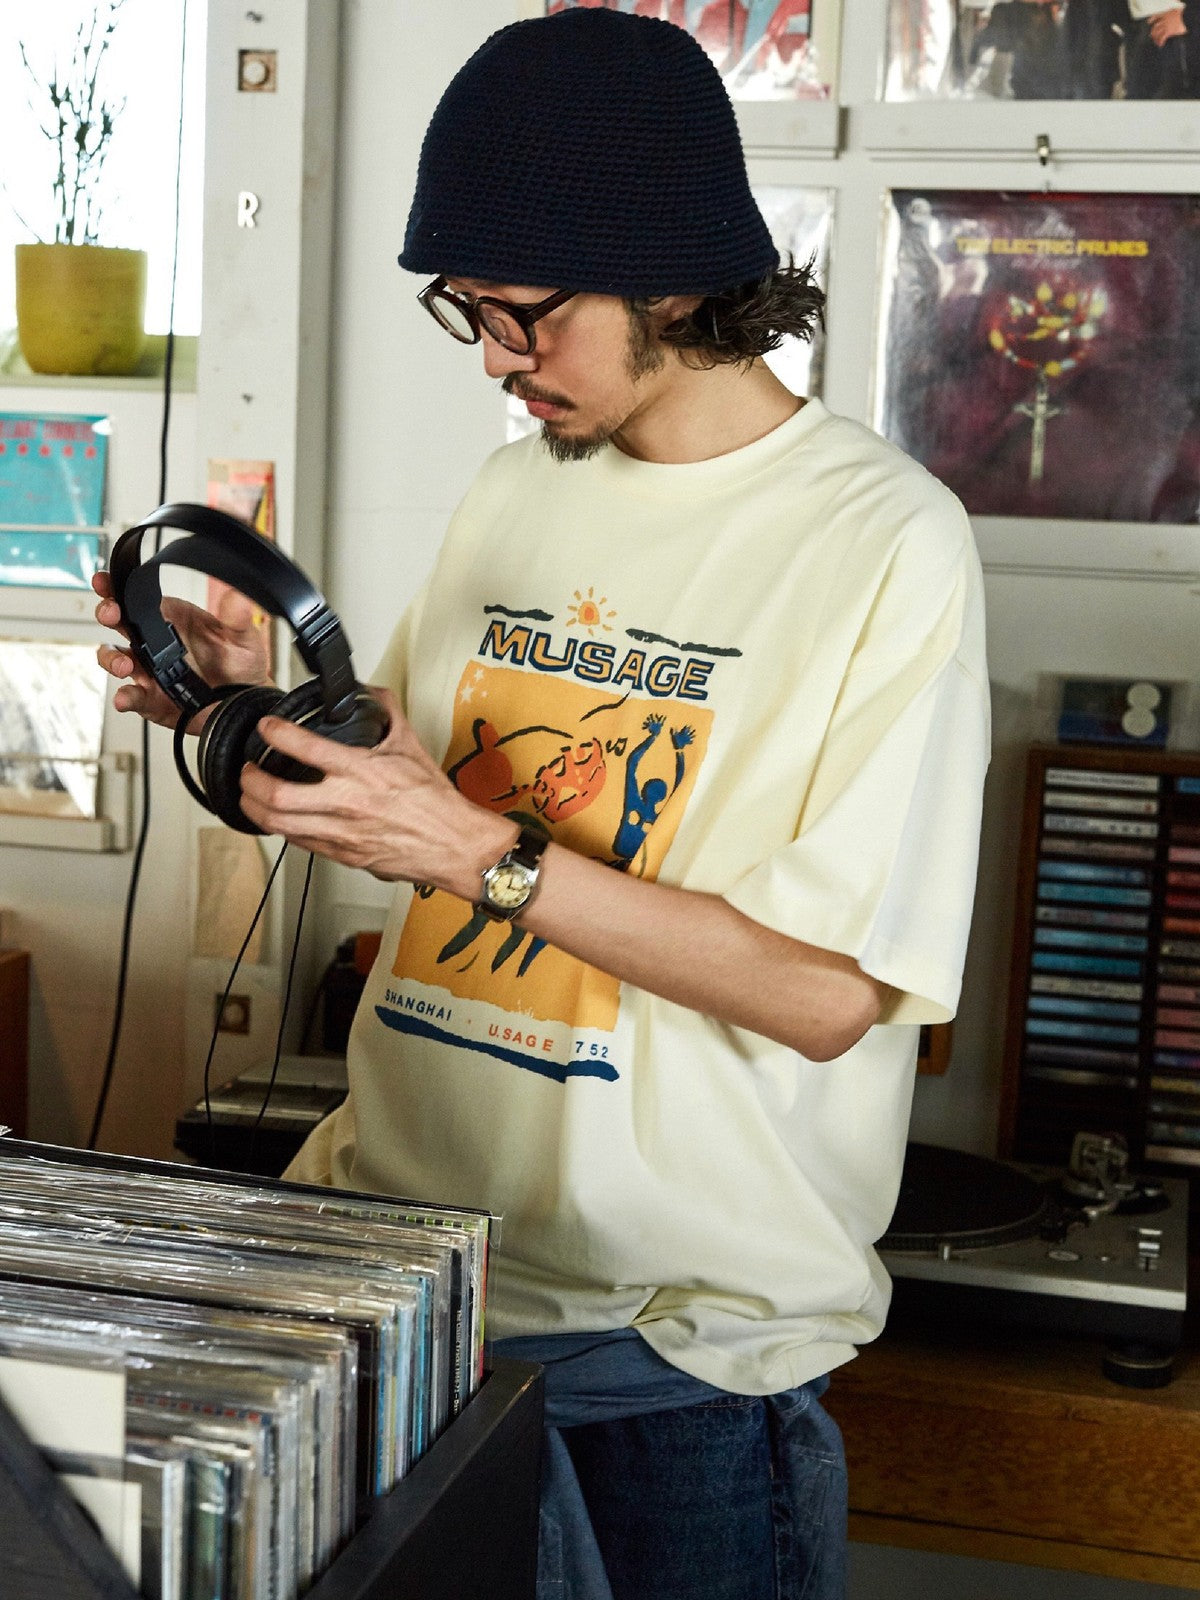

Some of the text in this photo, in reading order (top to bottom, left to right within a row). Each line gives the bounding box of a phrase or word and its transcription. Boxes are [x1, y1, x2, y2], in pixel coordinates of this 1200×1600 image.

[238, 191, 259, 228] R
[992, 237, 1074, 255] ELECTRIC
[1077, 239, 1149, 257] PRUNES
[478, 620, 715, 701] MUSAGE
[384, 988, 452, 1022] SHANGHAI
[488, 1023, 554, 1052] U.SAGE
